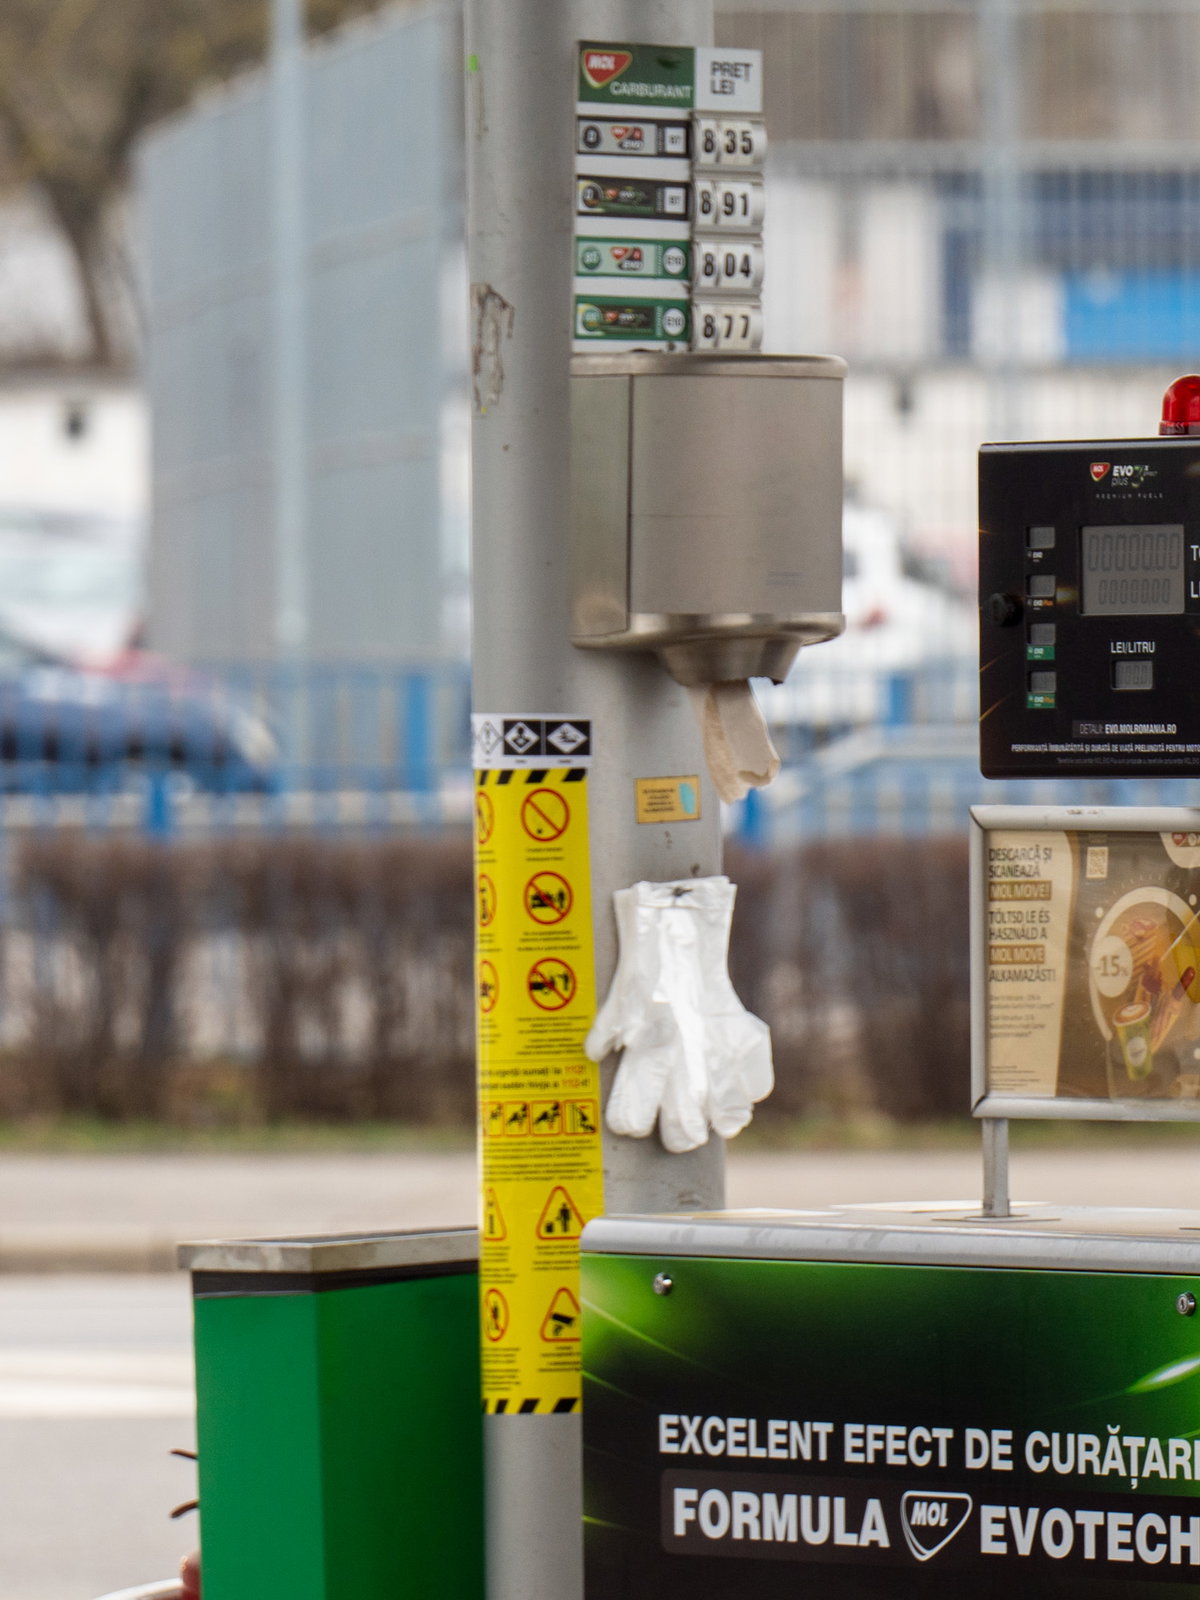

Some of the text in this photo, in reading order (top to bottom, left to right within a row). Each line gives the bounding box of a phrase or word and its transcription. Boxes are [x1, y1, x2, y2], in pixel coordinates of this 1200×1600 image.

[610, 81, 692, 98] CARBURANT
[711, 79, 735, 95] LEI
[1112, 465, 1133, 476] EVO
[1110, 642, 1155, 654] LEI/LITRU
[1105, 723, 1177, 735] EVO.MOLROMANIA.RO
[989, 845, 1041, 862] DESCARCĂ
[988, 862, 1040, 878] SCANEAZĂ
[1025, 909, 1036, 923] LE
[1039, 907, 1050, 924] ÉS
[1040, 927, 1047, 940] A
[658, 1413, 834, 1461] EXCELENT
[844, 1423, 954, 1467] EFECT
[965, 1428, 1014, 1471] DE
[674, 1487, 1200, 1566] FORMULA MOL EVOTECH
